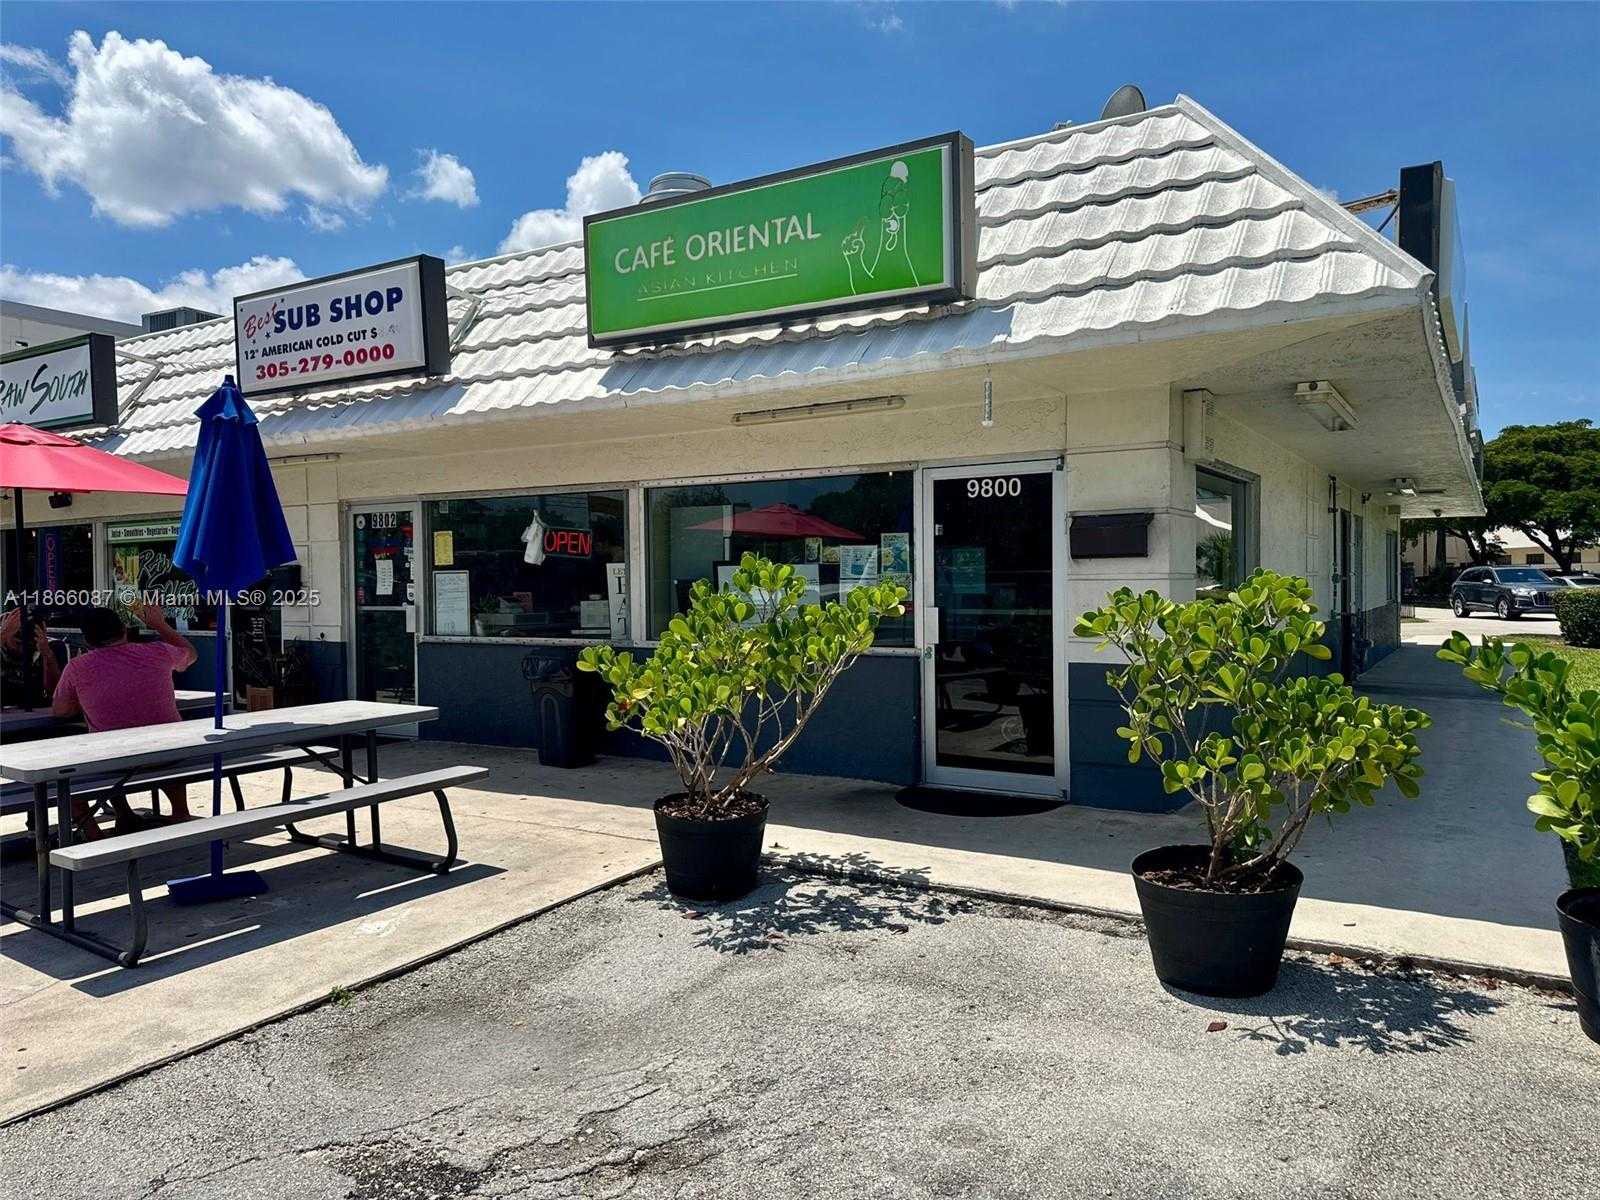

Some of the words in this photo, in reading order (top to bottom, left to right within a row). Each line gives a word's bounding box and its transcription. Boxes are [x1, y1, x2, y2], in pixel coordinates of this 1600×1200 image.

[615, 236, 676, 274] CAFÉ
[685, 212, 822, 261] ORIENTAL
[637, 275, 697, 295] ASIAN
[705, 257, 798, 285] KITCHEN
[243, 301, 278, 339] Best
[273, 303, 321, 334] SUB
[329, 287, 403, 323] SHOP
[255, 343, 395, 380] 305-279-0000
[261, 340, 313, 358] AMERICAN
[316, 334, 344, 348] COLD
[347, 330, 367, 343] CUT
[29, 363, 89, 415] SOUTH
[966, 477, 1022, 498] 9800
[372, 512, 397, 528] 9802
[543, 530, 592, 556] OPEN
